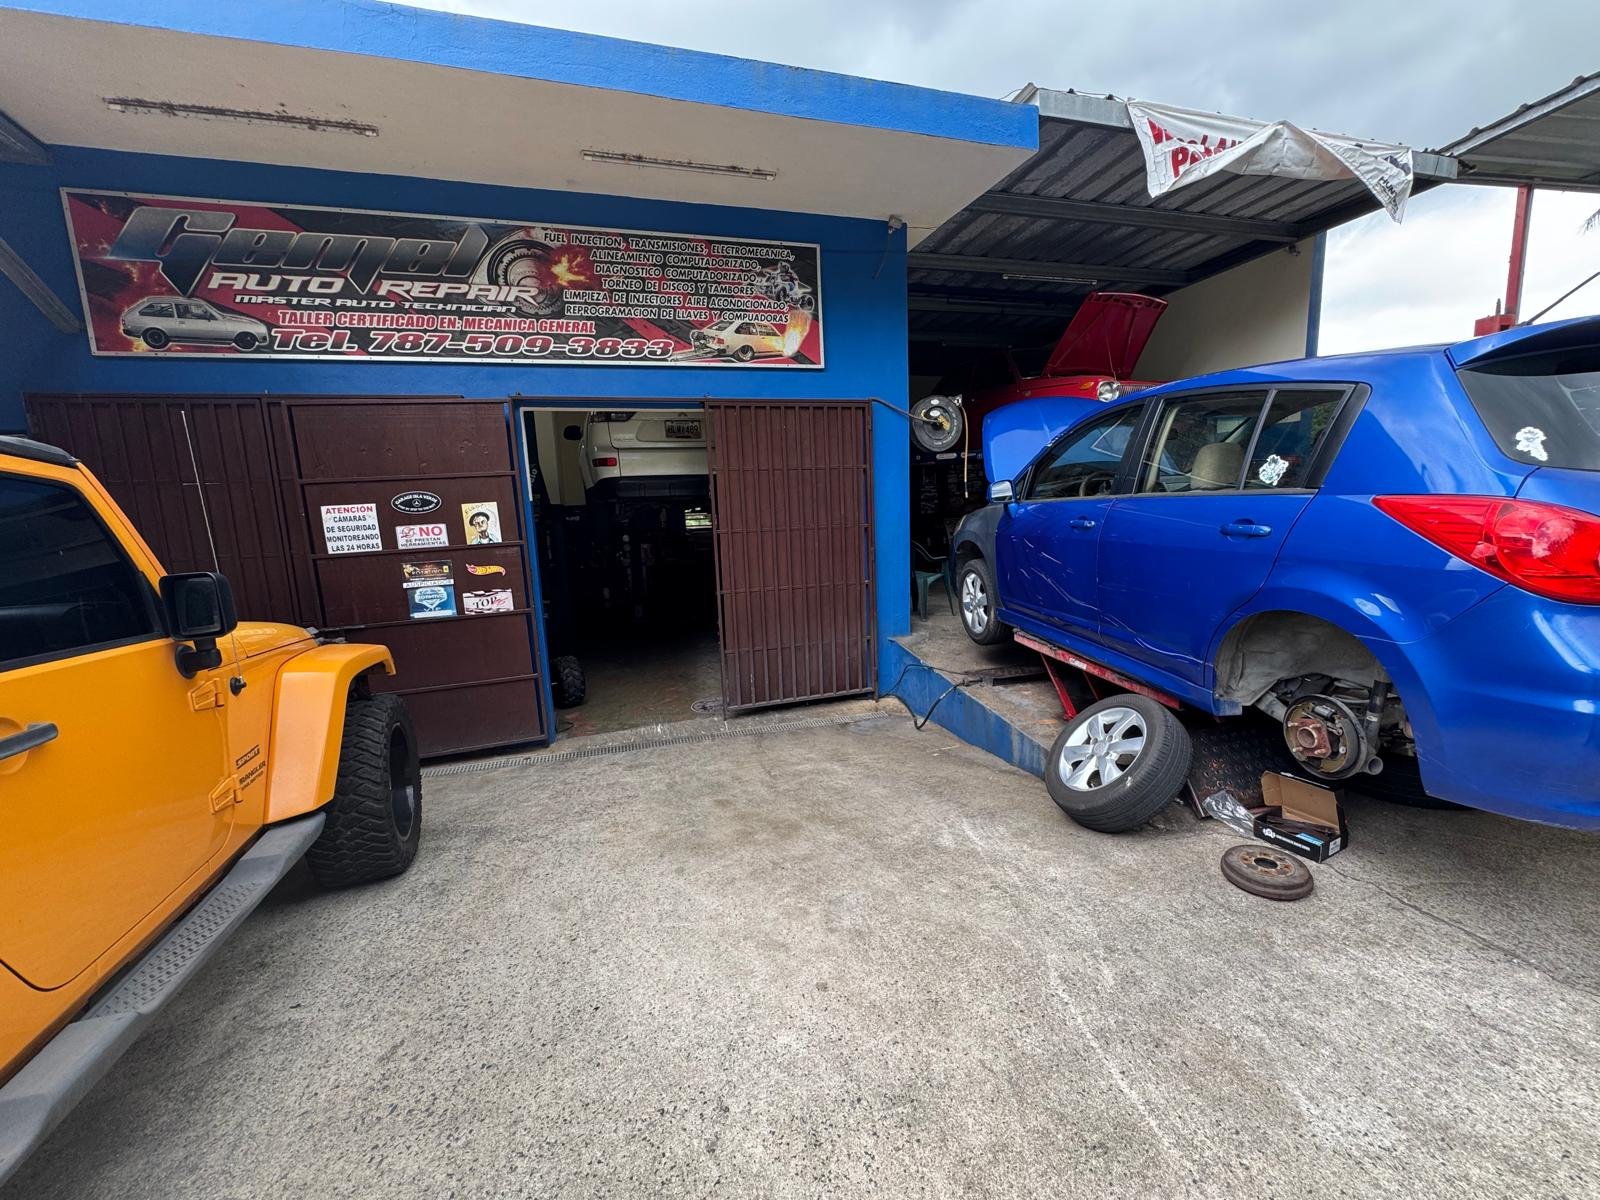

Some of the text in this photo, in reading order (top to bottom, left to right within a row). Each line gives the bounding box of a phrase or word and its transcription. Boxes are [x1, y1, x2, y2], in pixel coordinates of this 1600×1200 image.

[544, 232, 795, 260] FUEL INJECTION, TRANSMISIONES, ELECTROMECANICA,
[590, 250, 761, 270] ALINEAMIENTO COMPUTADORIZADO,
[594, 264, 662, 277] DIAGNOSTICO
[207, 272, 539, 307] AUTO REPAIR
[602, 279, 754, 295] TORNEO DE DISCOS Y TAMBORES
[235, 294, 516, 313] MASTER AUTO TECHNICIAN
[564, 290, 789, 312] LIMPIEZA DE INJECTORES AIRE ACONDICIONADO,
[277, 310, 596, 334] TALLER CERTIFICADO EN: MECANICA GENERAL
[565, 304, 789, 324] REPROGRAMACION DE LLAVES Y COMPUADORAS
[271, 328, 674, 358] Tel. 787-509-3833
[327, 534, 379, 543] MONITOREANDO
[337, 524, 377, 533] SEGURIDAD
[418, 526, 443, 537] NO
